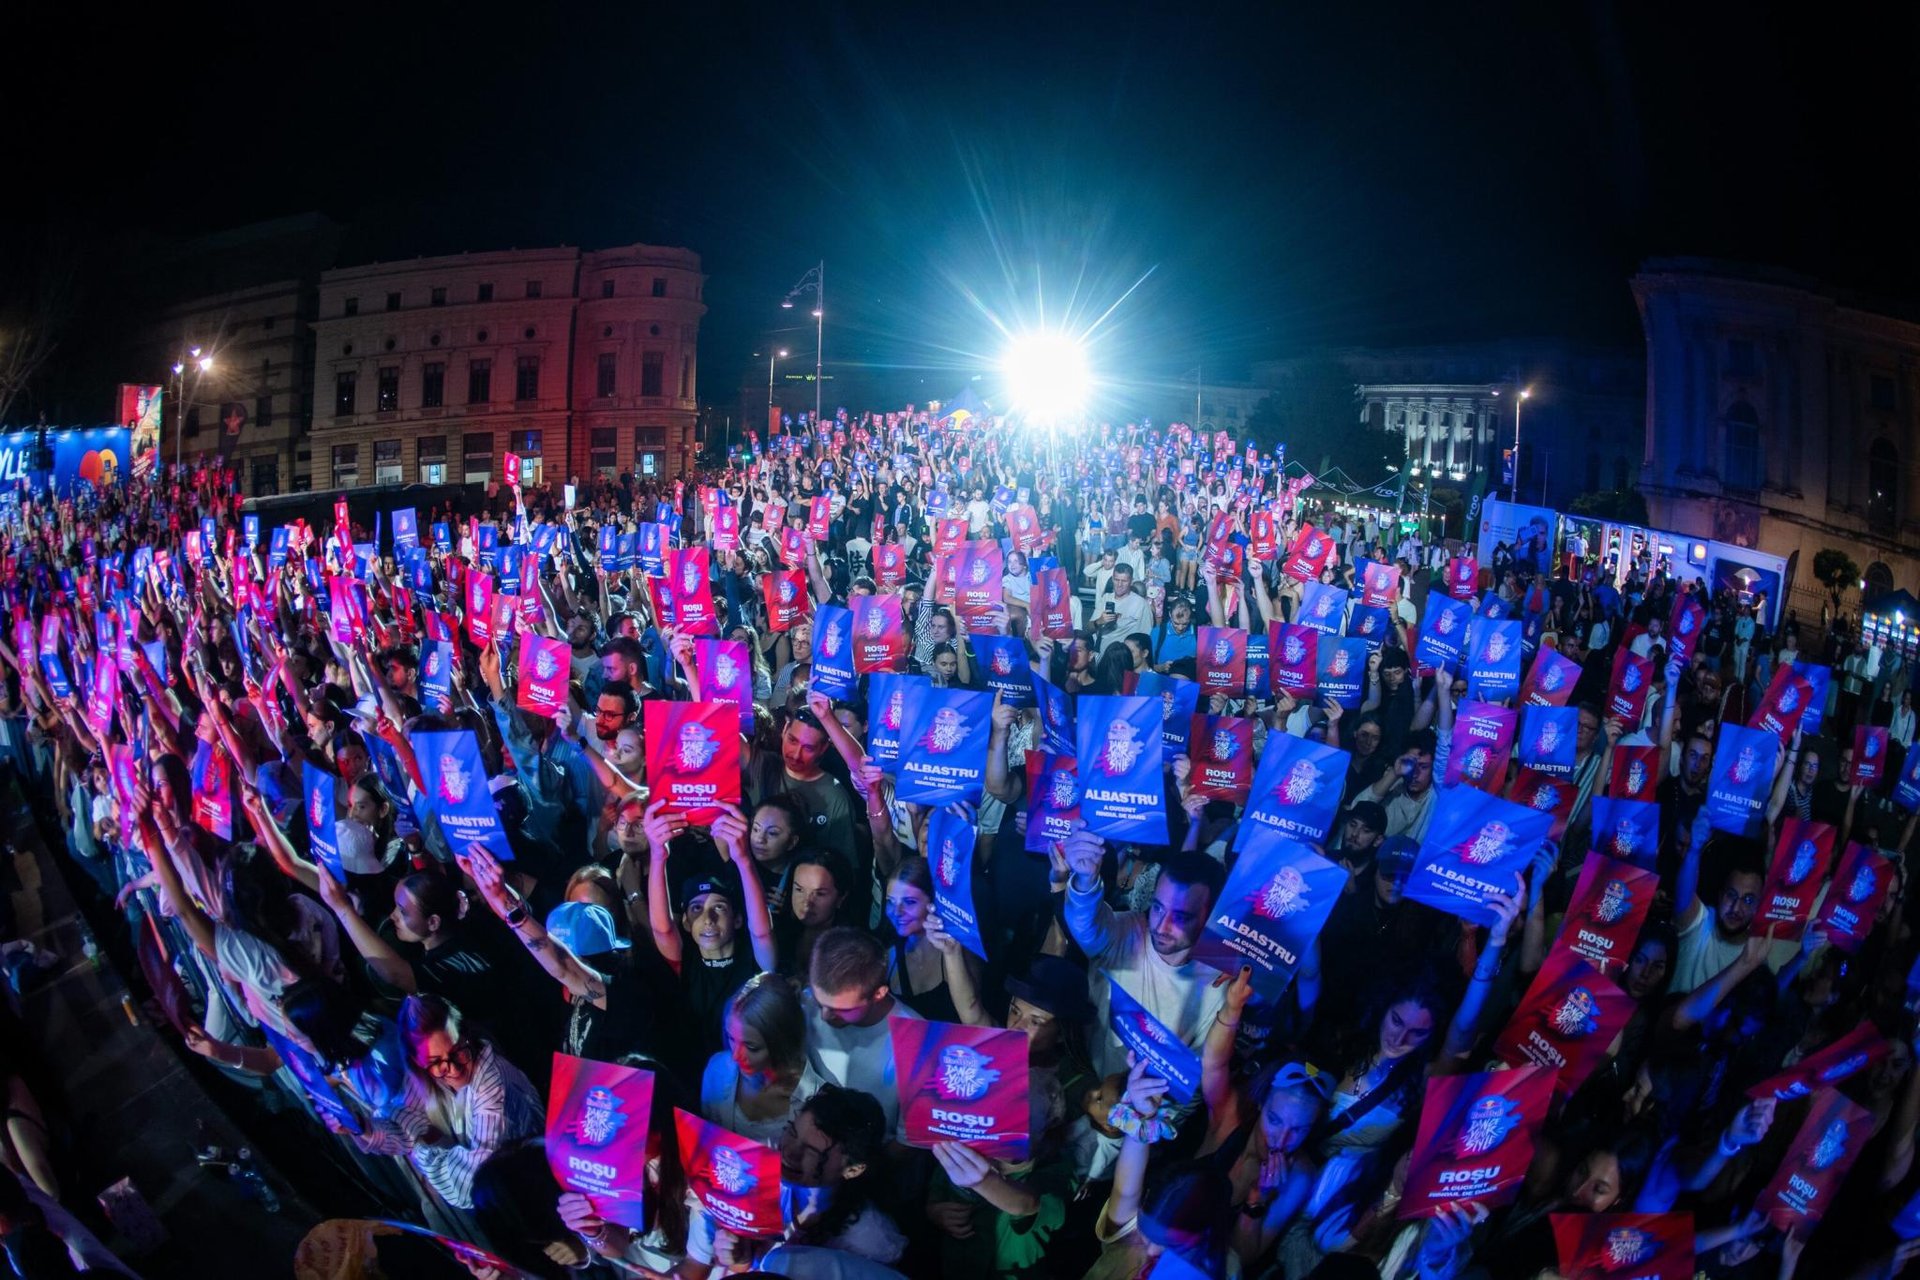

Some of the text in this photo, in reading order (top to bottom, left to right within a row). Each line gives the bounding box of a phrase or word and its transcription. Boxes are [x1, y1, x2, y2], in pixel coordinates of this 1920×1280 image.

[1423, 636, 1458, 656] ALBASTRU
[816, 664, 852, 679] ALBASTRU
[1472, 671, 1516, 681] ALBASTRU
[1318, 682, 1360, 690] ALBASTRU
[873, 738, 900, 749] ALBA
[904, 761, 979, 779] ALBASTRU
[1205, 768, 1235, 782] ROȘU
[672, 784, 717, 796] ROȘU
[1085, 788, 1158, 806] ALBASTRU
[1712, 790, 1762, 810] ALBASTRU
[440, 814, 496, 827] ALBASTRU
[1045, 816, 1071, 831] ROȘ
[1250, 810, 1323, 839] ALBASTRU
[1426, 863, 1506, 894] ALBASTRU
[1217, 915, 1296, 965] ALBASTRU
[1577, 928, 1614, 950] ROȘU
[1528, 1030, 1567, 1068] ROȘU
[931, 1108, 995, 1129] ROȘU
[569, 1156, 617, 1180] ROȘU
[1439, 1165, 1501, 1184] ROȘU
[706, 1193, 754, 1221] ROȘU
